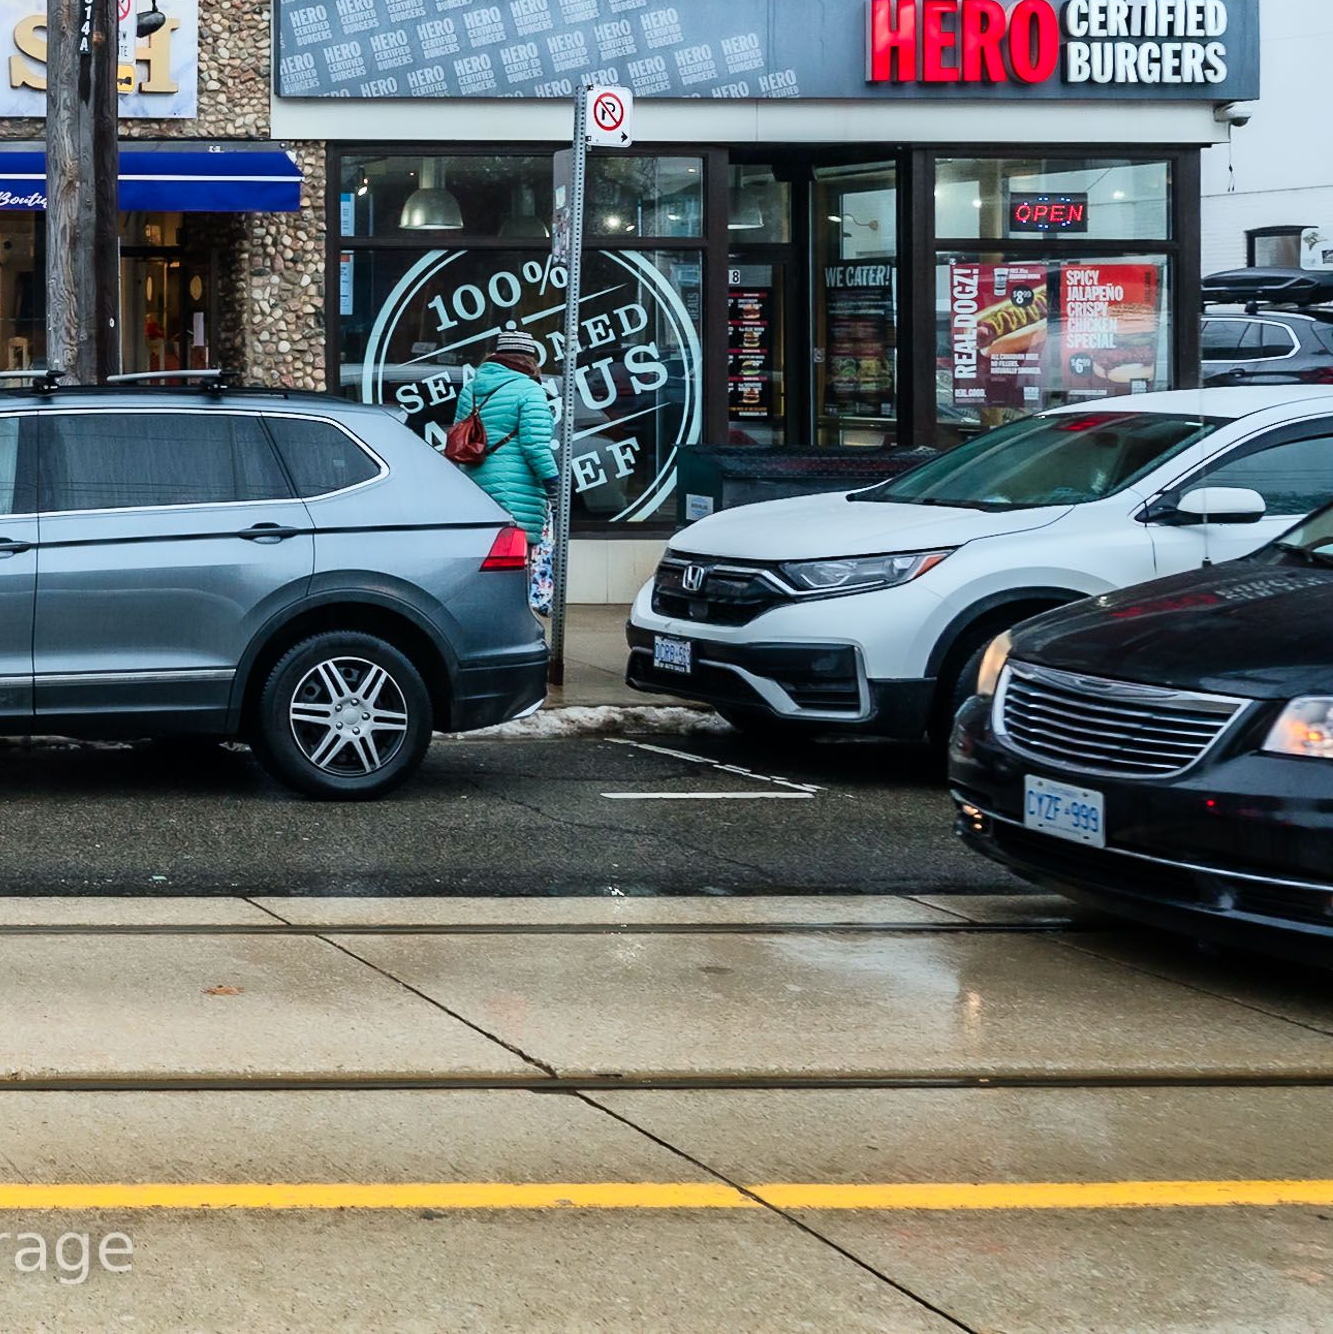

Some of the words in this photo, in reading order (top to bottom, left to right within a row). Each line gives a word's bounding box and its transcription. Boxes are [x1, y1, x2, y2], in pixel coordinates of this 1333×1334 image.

[290, 6, 328, 28] HERO
[463, 7, 501, 29] HERO
[641, 8, 679, 31] HERO
[417, 18, 455, 41] HERO
[594, 20, 632, 43] HERO
[324, 42, 362, 64] HERO
[370, 30, 408, 53] HERO
[547, 31, 585, 54] HERO
[721, 33, 759, 56] HERO
[454, 54, 492, 77] HERO
[501, 43, 539, 66] HERO
[675, 45, 713, 68] HERO
[1065, 41, 1228, 84] BURGERS
[407, 66, 445, 89] HERO
[628, 56, 666, 79] HERO
[759, 70, 797, 93] HERO
[1014, 203, 1084, 223] OPEN
[824, 267, 844, 287] WE
[846, 265, 891, 287] CATER!
[1066, 270, 1100, 286] SPICY
[428, 254, 568, 332] 100%
[1066, 283, 1124, 302] JALAPEÑO
[1066, 301, 1109, 318] CRISPY
[1067, 317, 1117, 333] CHICKEN
[1067, 333, 1117, 349] SPECIAL
